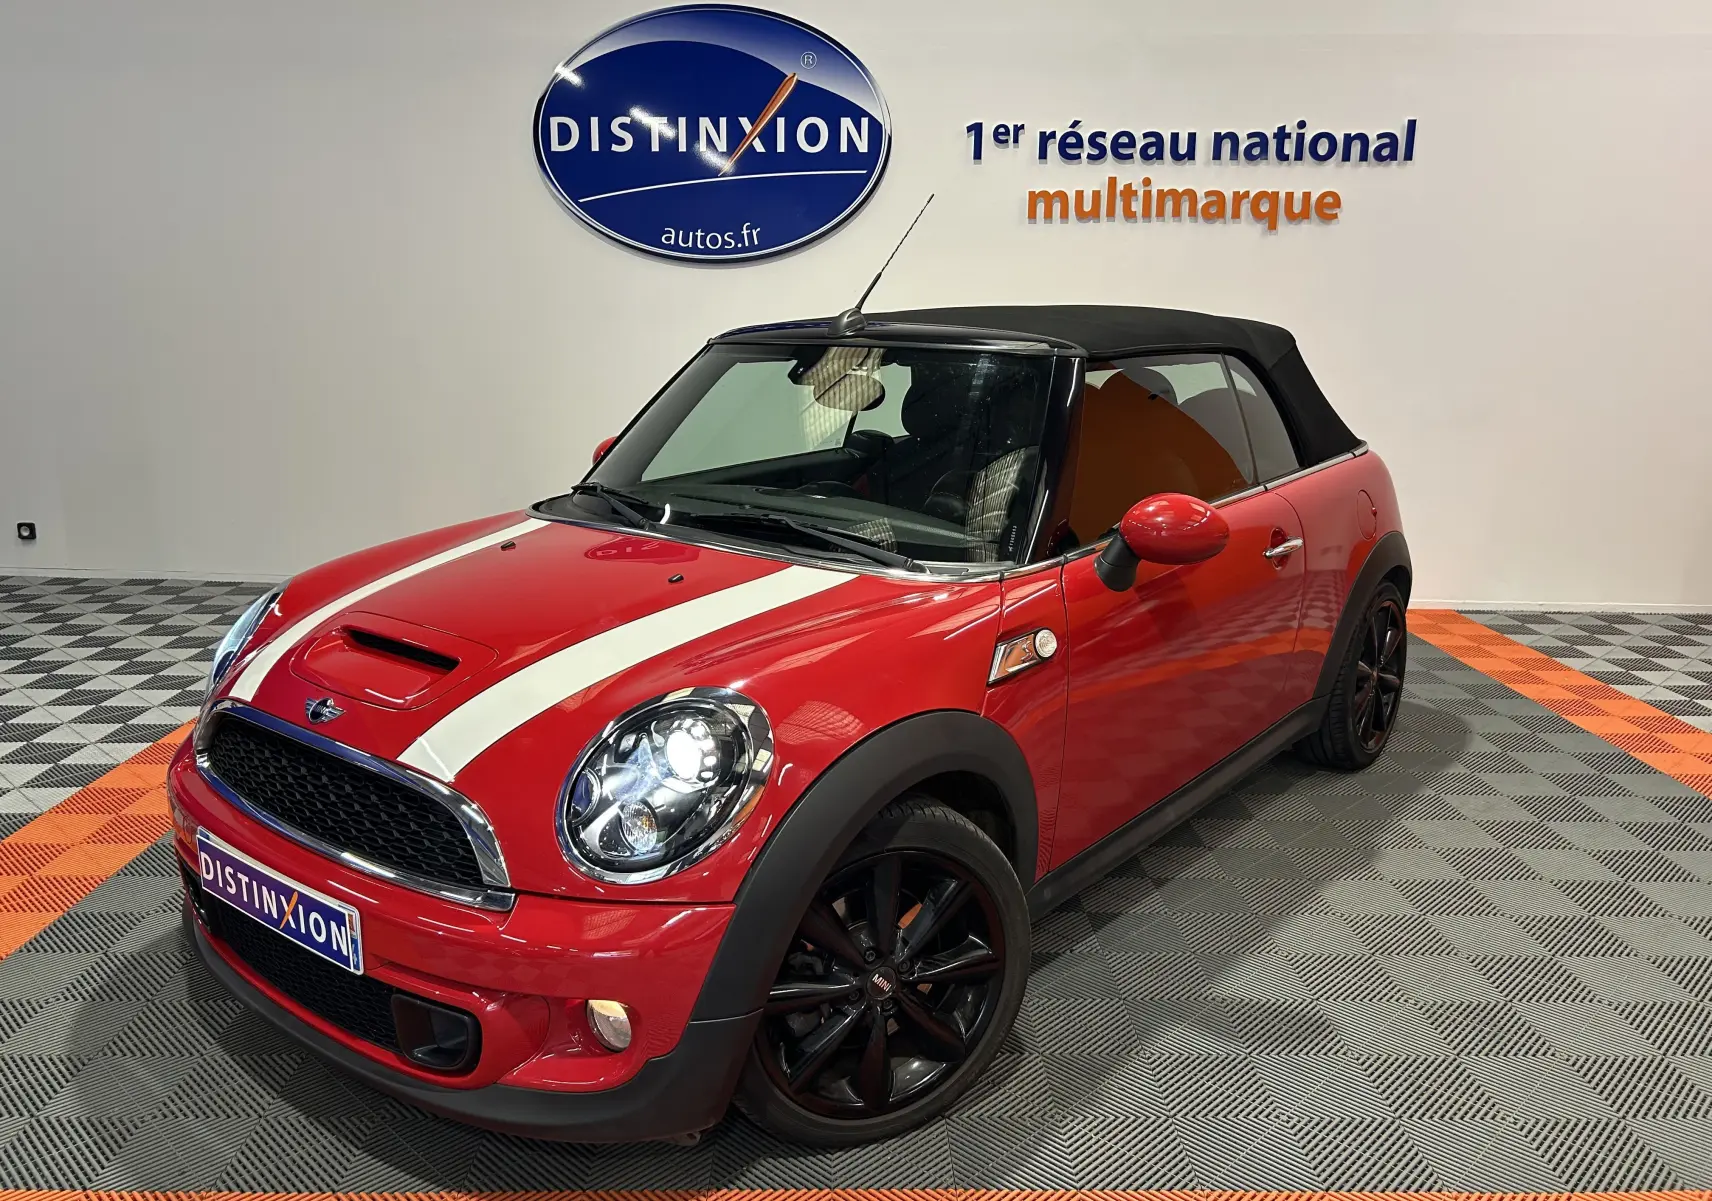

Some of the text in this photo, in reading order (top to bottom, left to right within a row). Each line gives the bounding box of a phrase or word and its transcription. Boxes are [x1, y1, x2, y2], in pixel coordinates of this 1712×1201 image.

[549, 116, 869, 154] DISTINXION
[965, 118, 1417, 162] 1er réseau national
[1027, 176, 1342, 231] multimarque
[660, 222, 761, 249] autos.fr
[200, 851, 349, 957] DISTINXION
[872, 973, 892, 992] MINI
